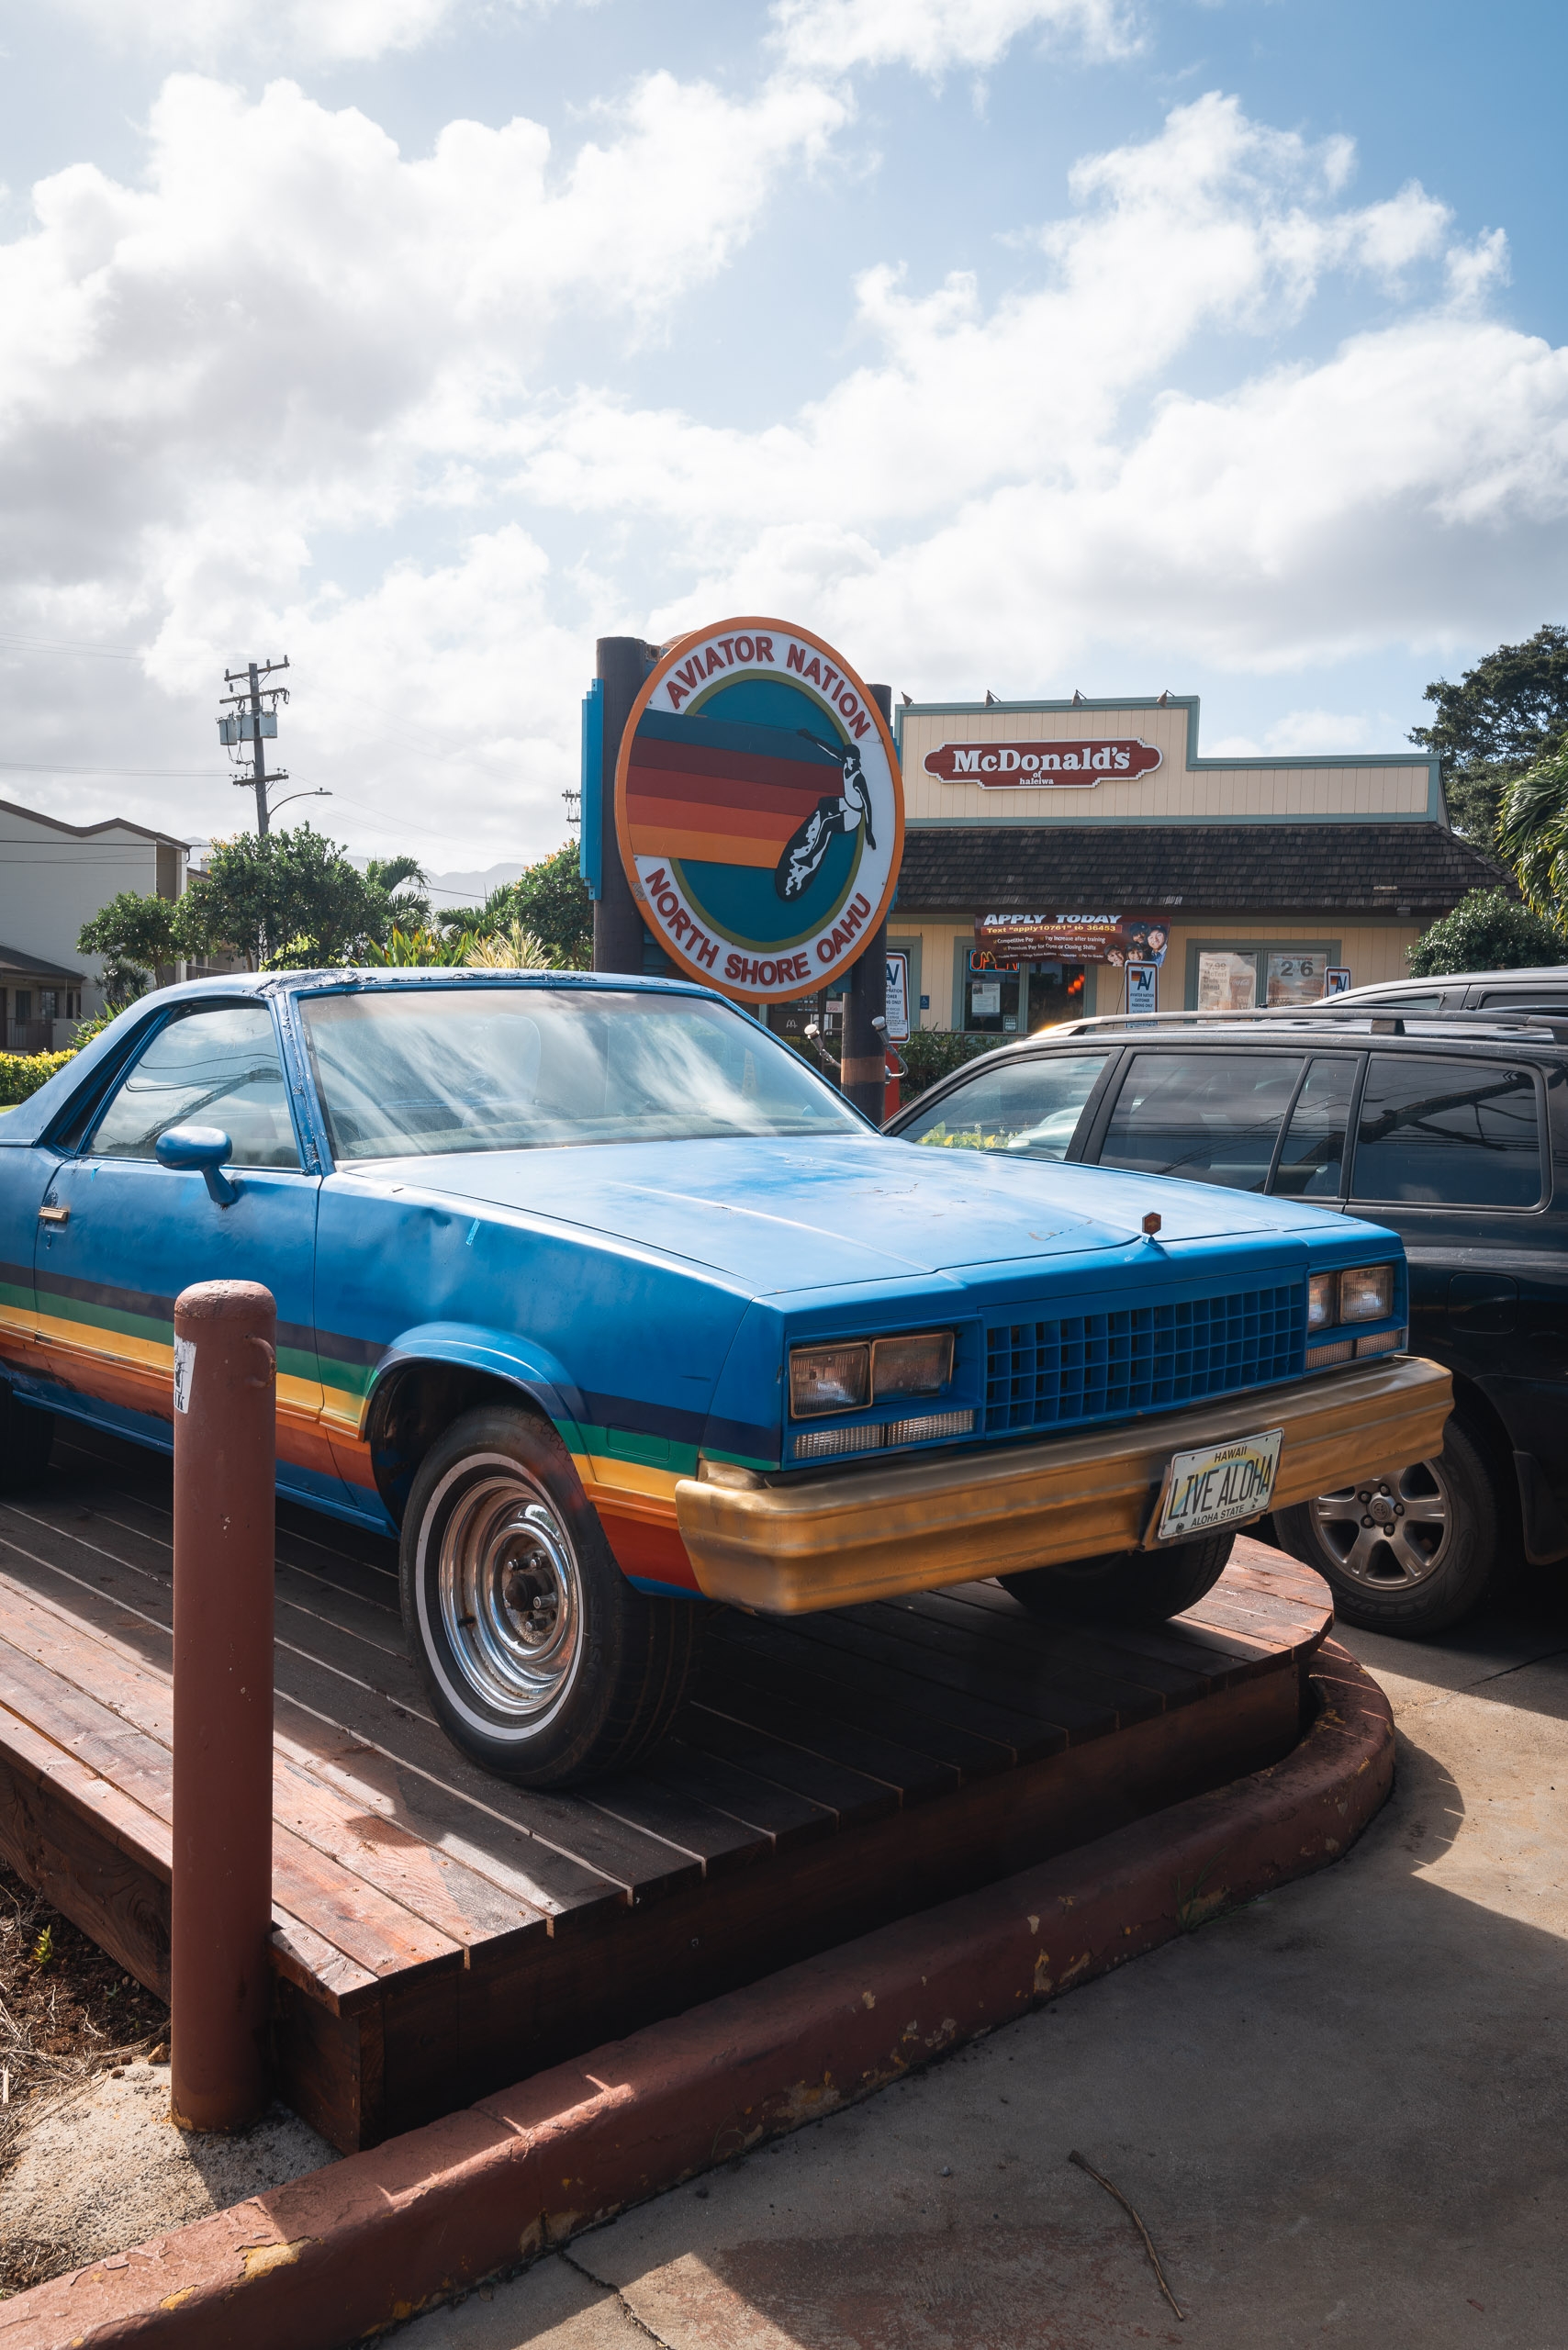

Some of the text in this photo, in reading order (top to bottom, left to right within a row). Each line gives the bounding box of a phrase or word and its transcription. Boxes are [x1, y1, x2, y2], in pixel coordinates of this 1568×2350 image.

[666, 636, 871, 739] AVIATOR NATION
[952, 746, 1130, 773] McDonald's
[1033, 770, 1042, 778] of
[644, 867, 871, 986] NORTH SHORE OAHU
[983, 913, 1122, 925] APPLY TODAY
[1281, 960, 1293, 976] 2
[1215, 1446, 1248, 1463] HAWAII
[1191, 1505, 1245, 1528] ALOHA STATE
